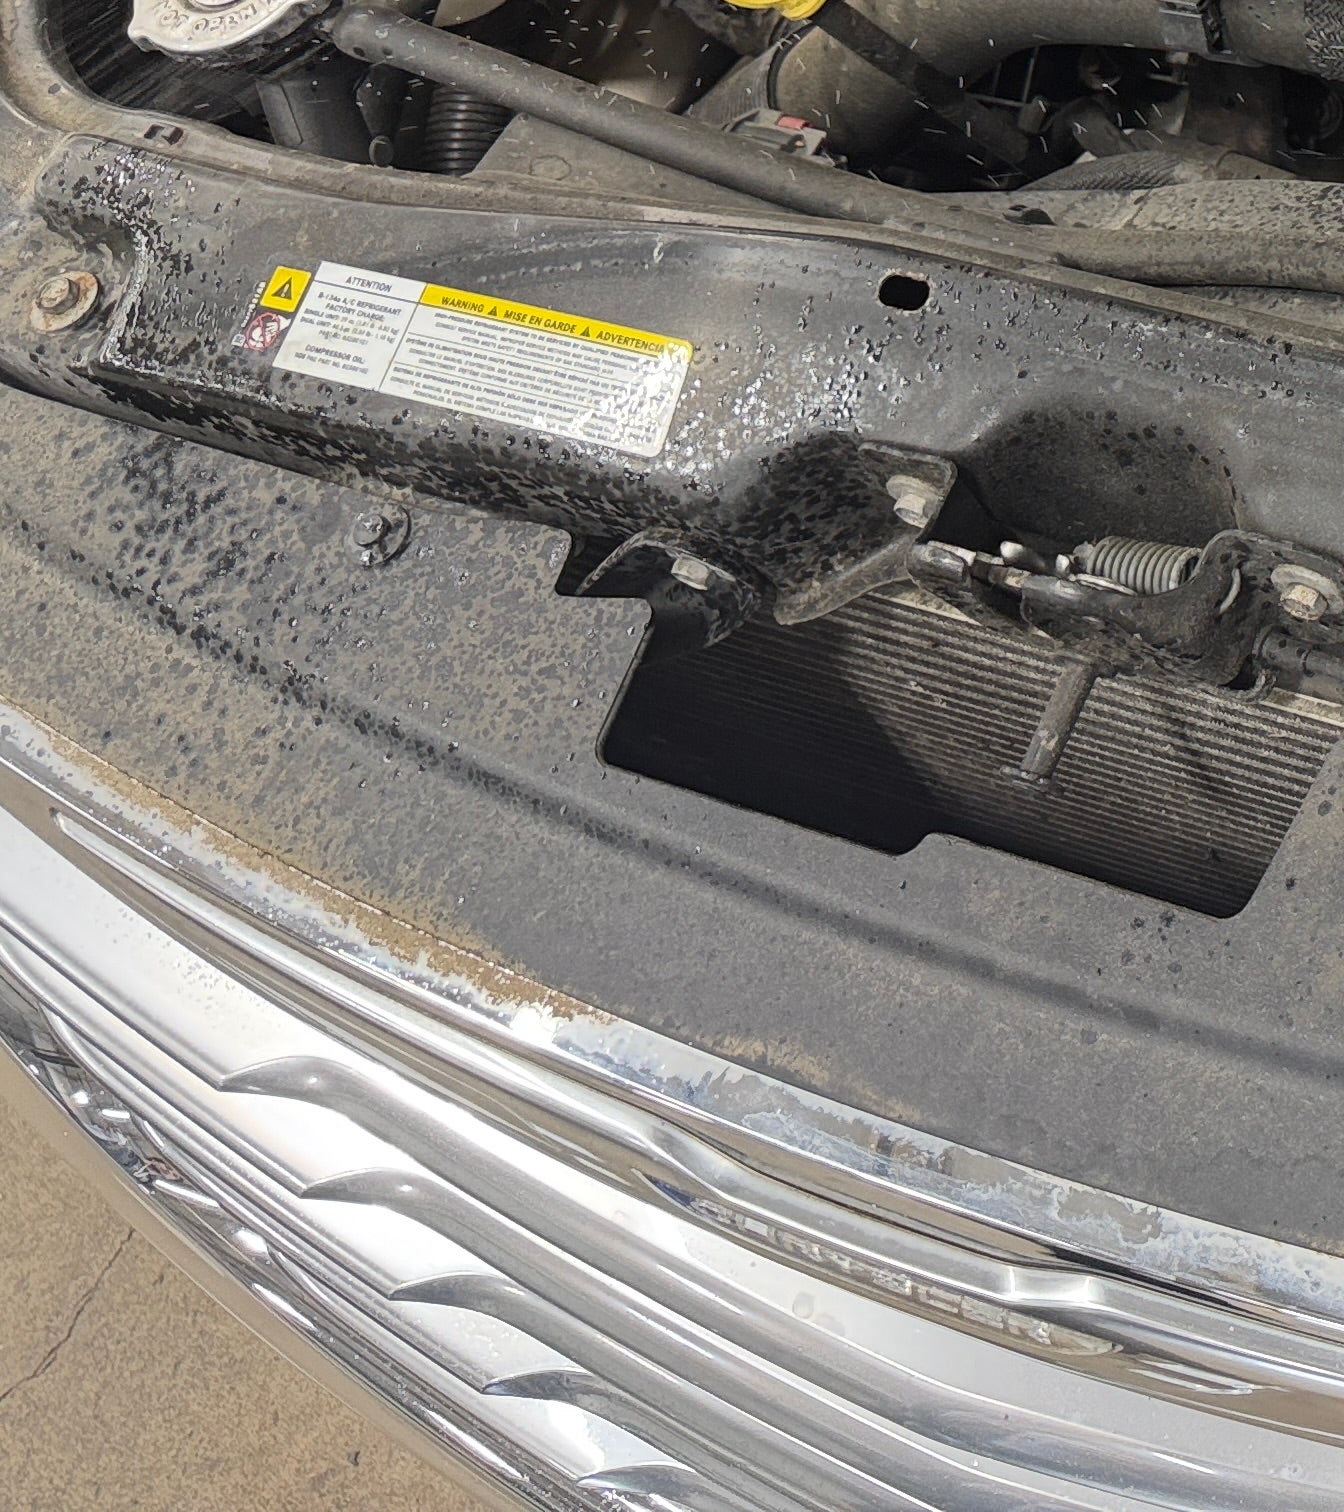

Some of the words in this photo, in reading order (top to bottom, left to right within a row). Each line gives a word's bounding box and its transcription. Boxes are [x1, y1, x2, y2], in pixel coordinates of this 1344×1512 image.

[344, 275, 392, 292] ATTENTION
[439, 295, 485, 313] WARNING
[502, 309, 528, 322] MISE
[528, 315, 543, 325] EN
[542, 318, 577, 333] GARDE
[595, 330, 665, 353] ADVERTENCIA
